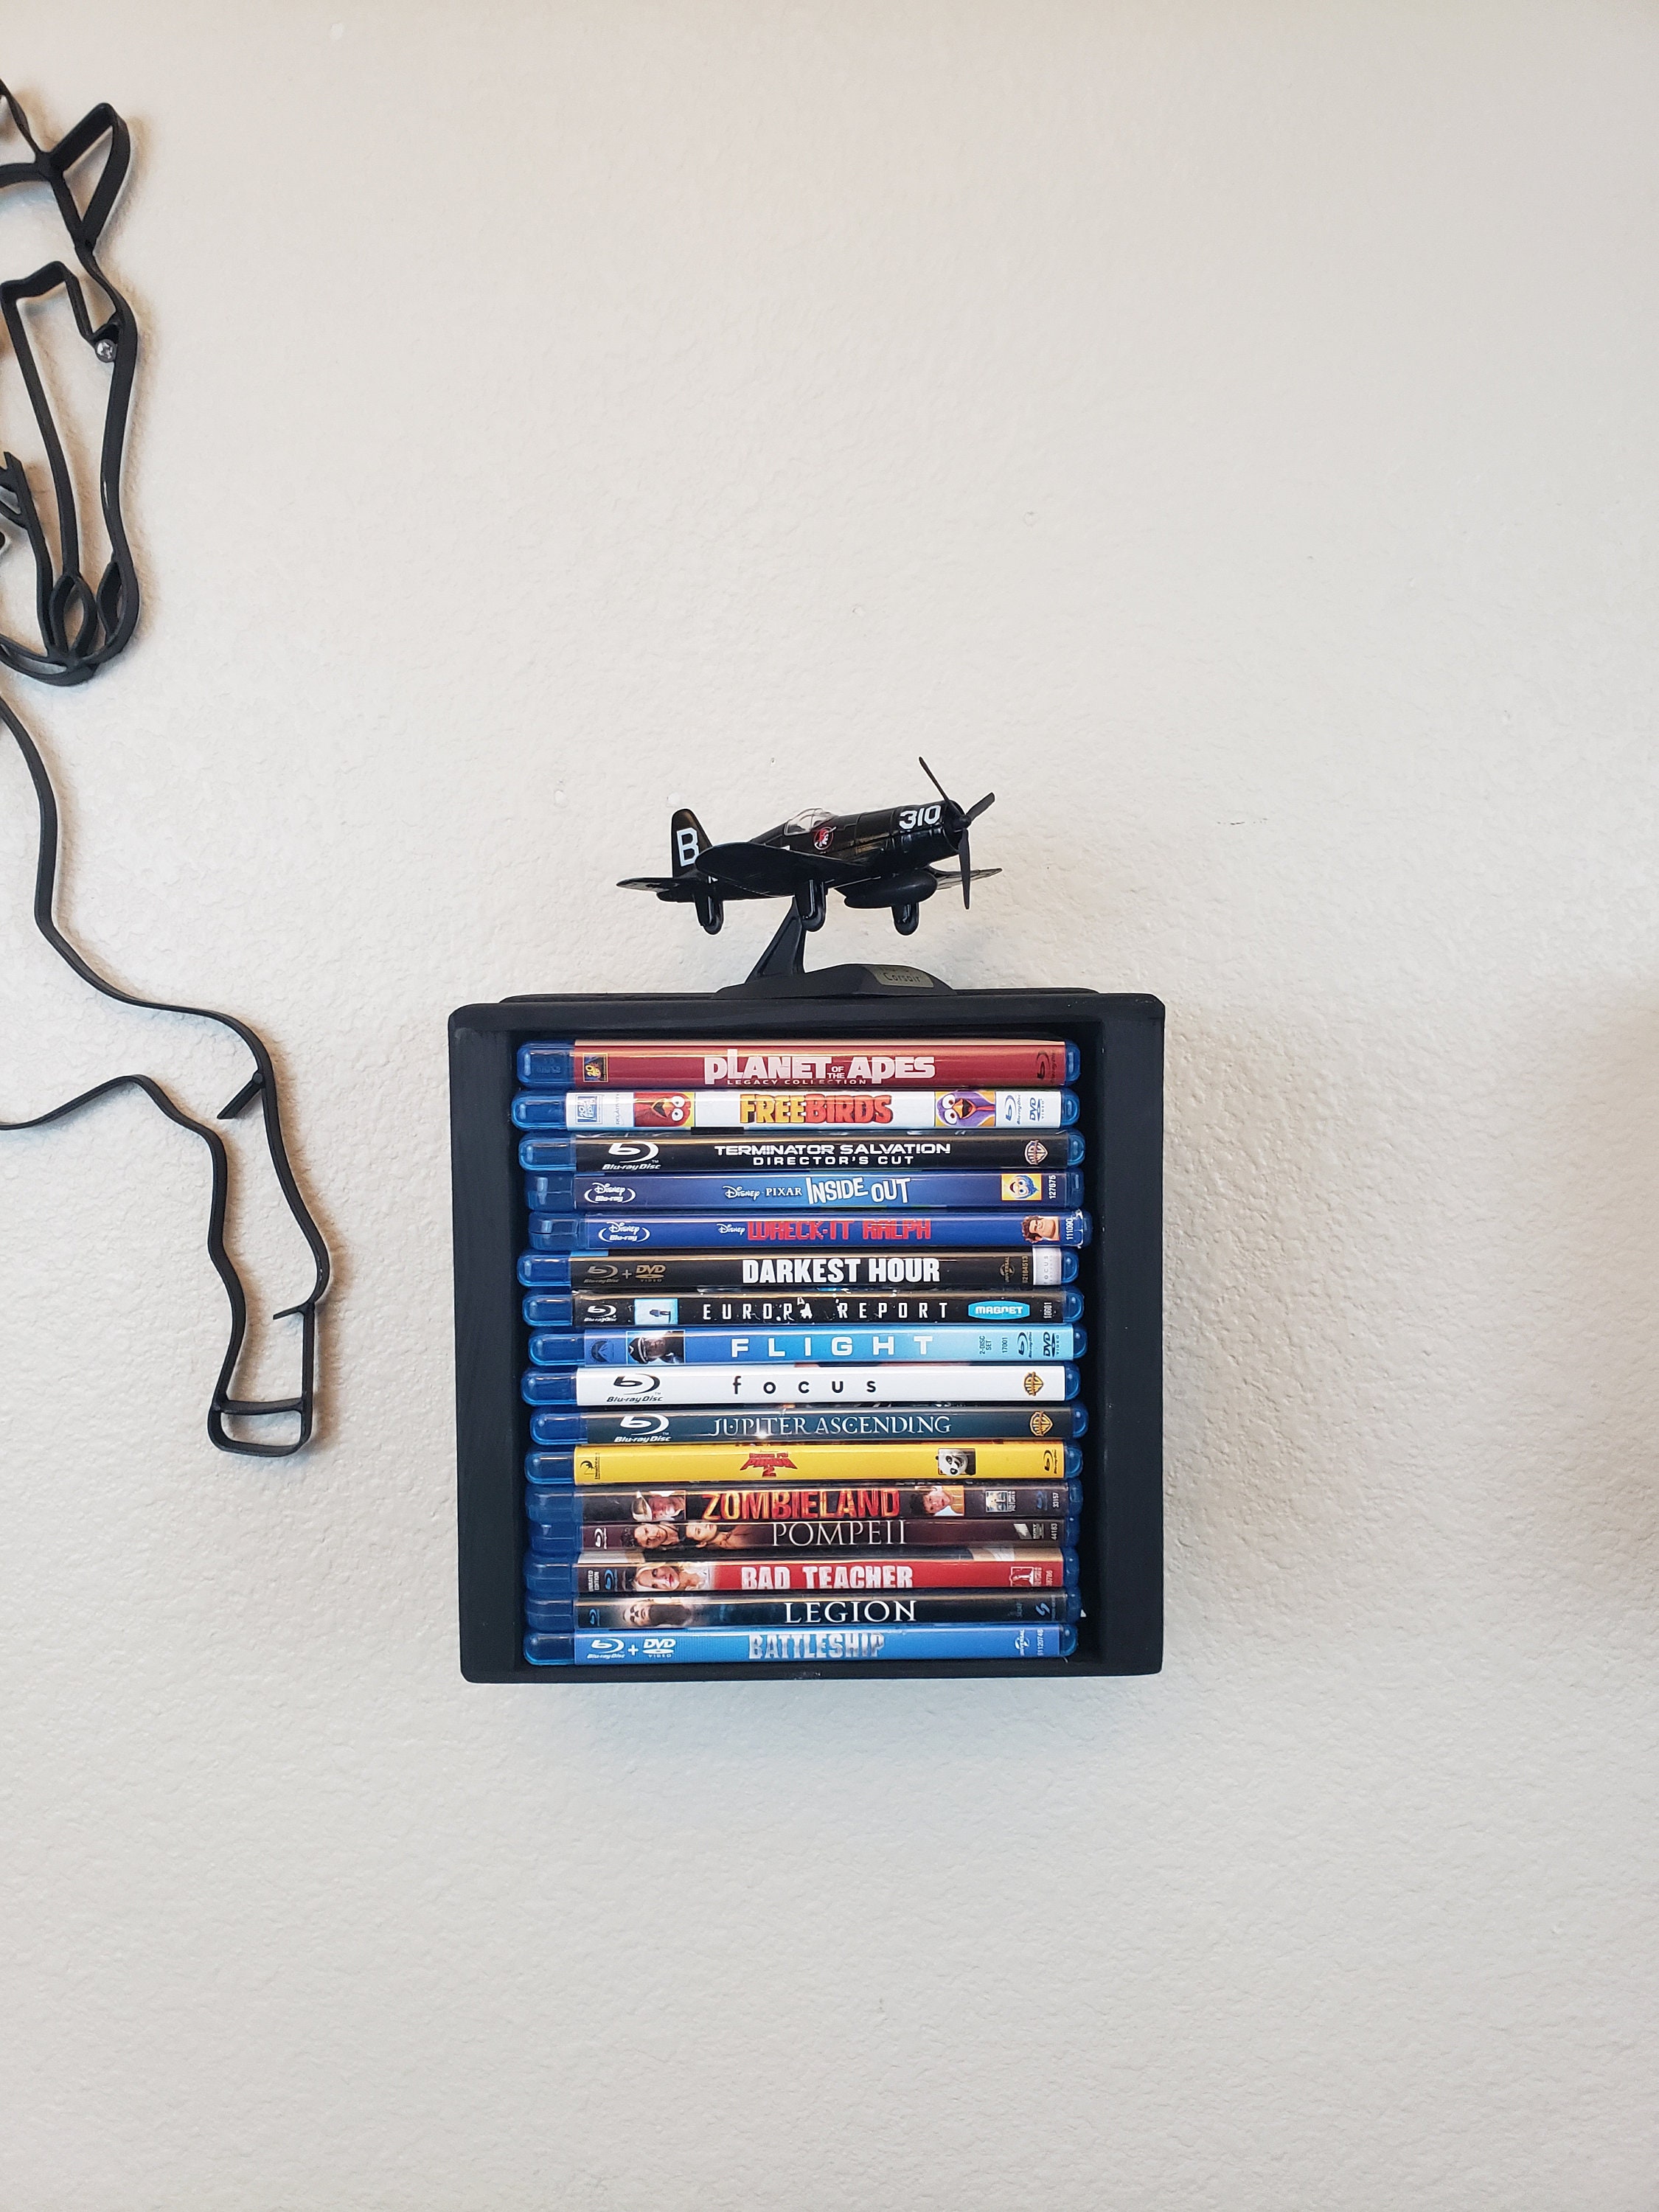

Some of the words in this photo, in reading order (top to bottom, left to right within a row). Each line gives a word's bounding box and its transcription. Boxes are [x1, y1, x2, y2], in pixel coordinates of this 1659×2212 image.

[899, 804, 942, 830] 310
[677, 827, 699, 866] B
[704, 1048, 832, 1085] PLANET
[846, 1056, 935, 1084] APES
[714, 1144, 835, 1155] TERMINATOR
[840, 1143, 951, 1155] SALVATION
[602, 1163, 639, 1171] Blu-ray
[753, 1155, 869, 1166] DIRECTOR'S
[877, 1155, 914, 1165] CUT
[591, 1183, 626, 1196] Disney
[595, 1194, 623, 1203] Blu-ray
[722, 1185, 760, 1199] Disney
[766, 1186, 802, 1197] PIXAR
[807, 1177, 869, 1205] INSIDE
[872, 1178, 911, 1203] OUT
[606, 1222, 640, 1234] Disney
[609, 1234, 637, 1242] Blu-ray
[716, 1223, 745, 1236] Disney
[747, 1219, 855, 1241] WRECK-IT
[862, 1219, 932, 1241] RALPH
[1065, 1218, 1074, 1240] 111090
[636, 1265, 666, 1273] DVD
[742, 1258, 861, 1284] DARKEST
[868, 1257, 940, 1283] HOUR
[837, 1302, 948, 1319] REPORT
[731, 1336, 933, 1358] FLIGHT
[1043, 1332, 1051, 1357] DVD
[732, 1375, 877, 1395] focus
[607, 1395, 641, 1403] Blu-ray
[708, 1416, 810, 1437] JUPITER
[815, 1415, 952, 1435] ASCENDING
[614, 1436, 649, 1444] Blu-ray
[702, 1488, 900, 1521] ZOMBIELAND
[772, 1520, 907, 1547] POMPEII
[741, 1566, 790, 1590] BAD
[802, 1565, 914, 1590] TEACHER
[784, 1600, 917, 1624] LEGION
[643, 1638, 676, 1649] DVD
[748, 1633, 885, 1660] BATTLESHIP
